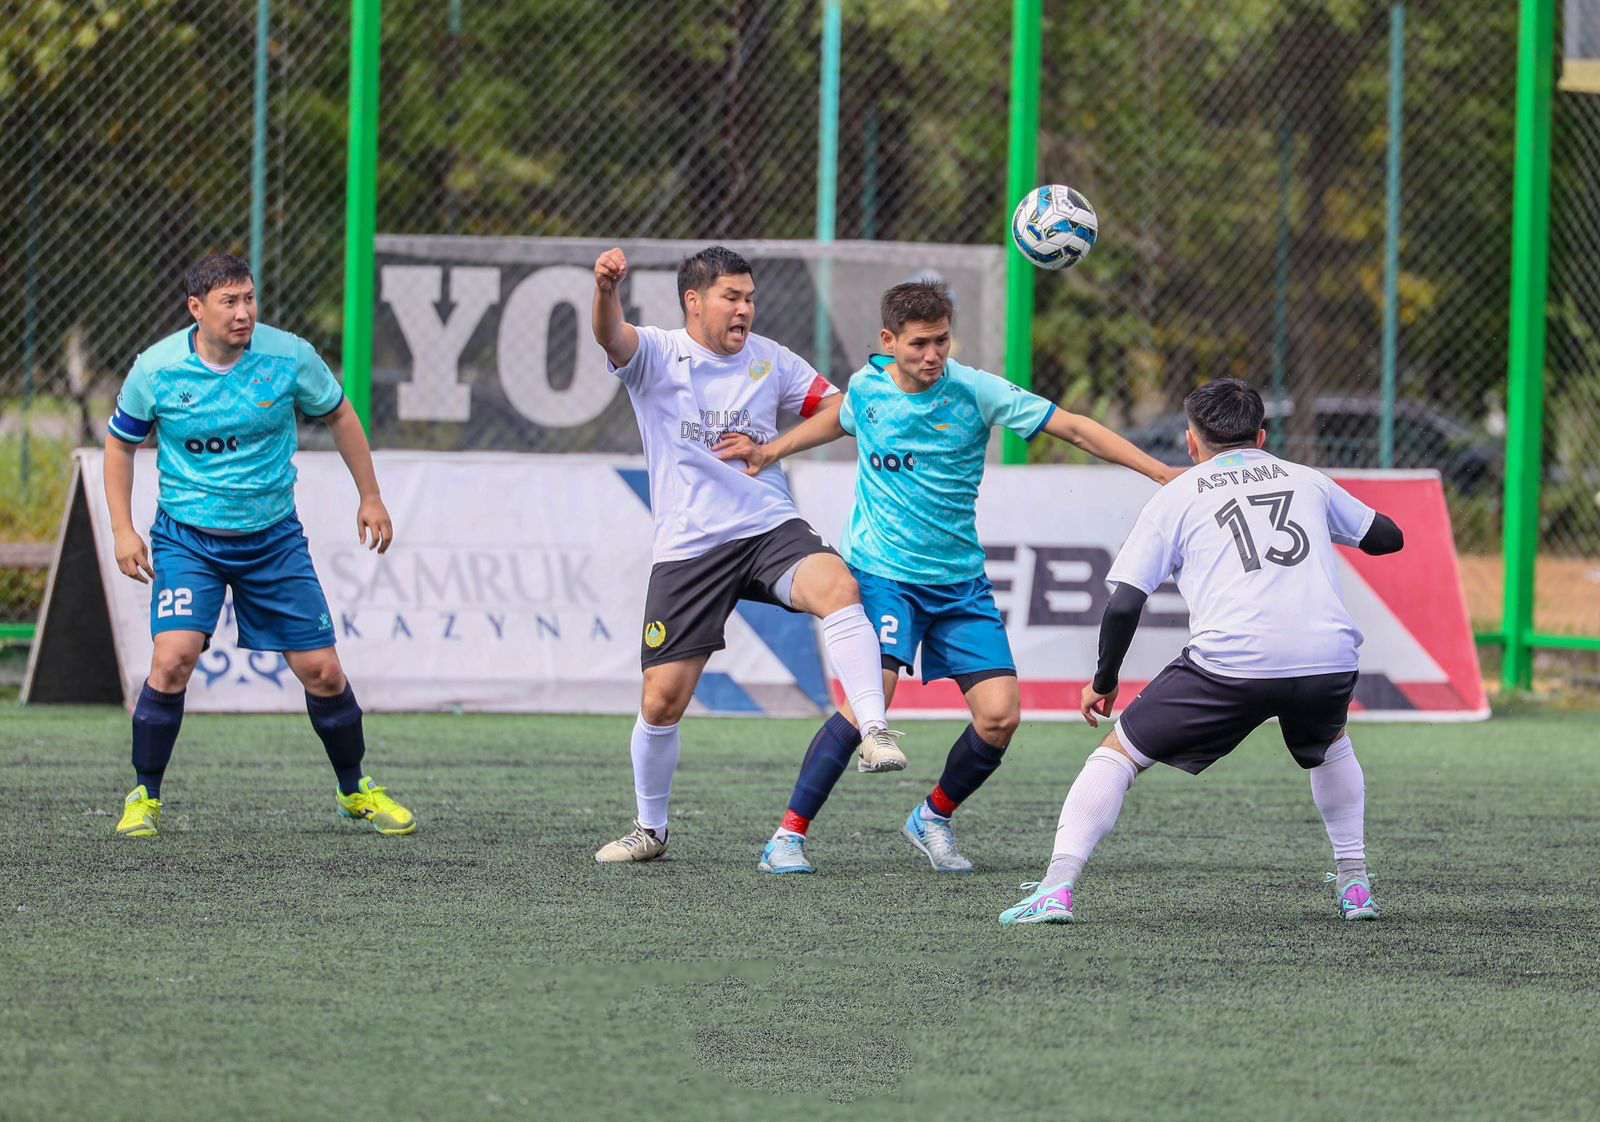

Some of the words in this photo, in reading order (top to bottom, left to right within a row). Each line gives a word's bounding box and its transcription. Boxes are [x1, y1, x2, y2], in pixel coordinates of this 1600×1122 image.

[1197, 464, 1288, 493] ASTANA
[1214, 490, 1310, 573] 13
[329, 551, 602, 604] SAMRUK
[157, 587, 193, 619] 22
[880, 614, 899, 645] 2
